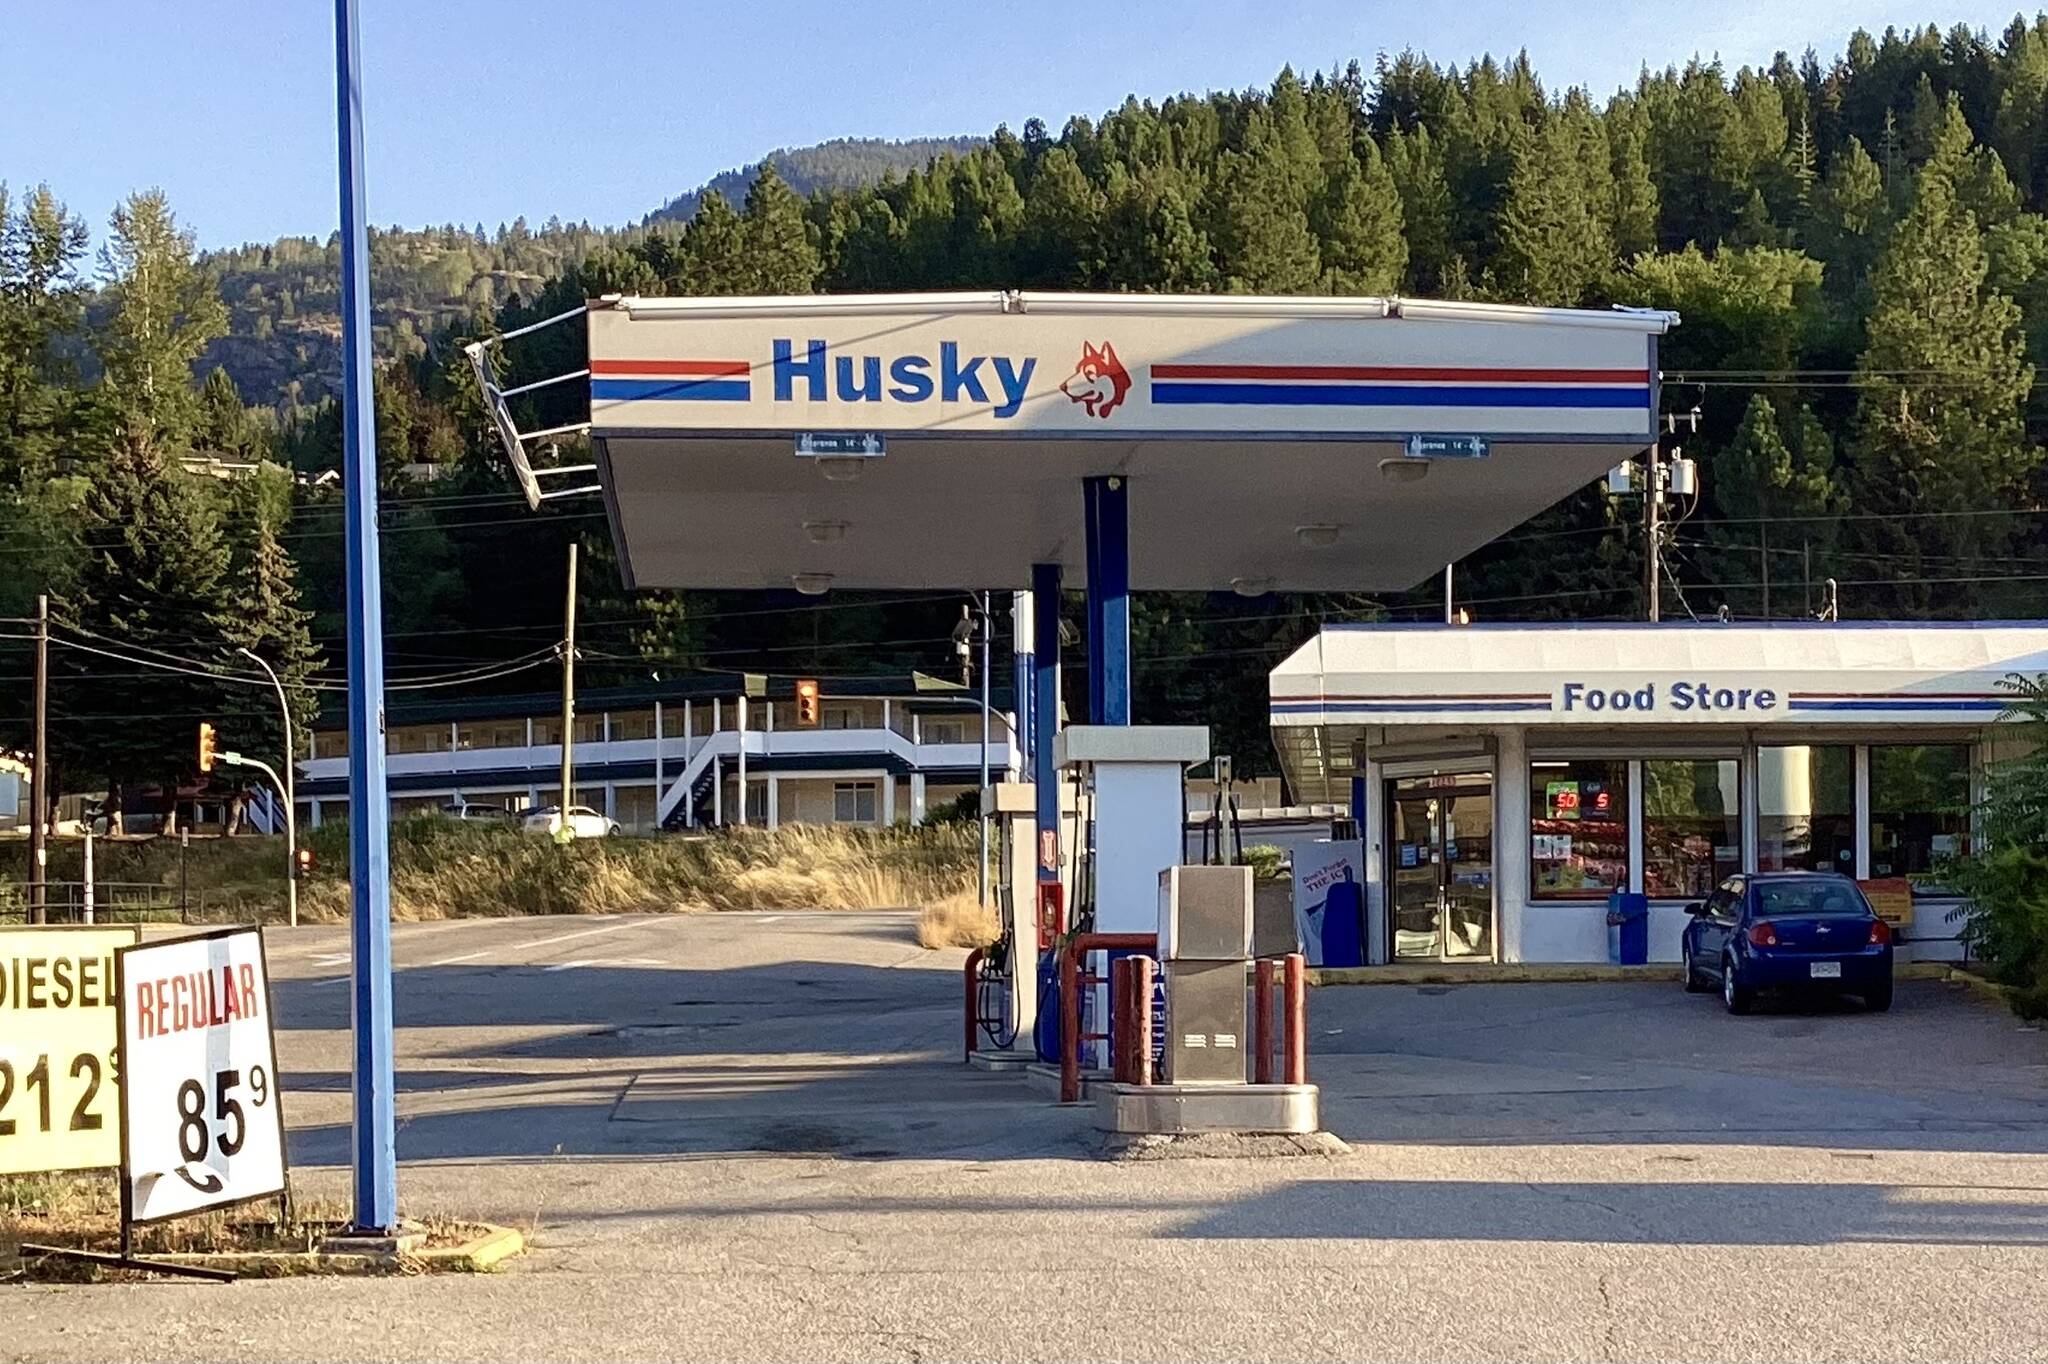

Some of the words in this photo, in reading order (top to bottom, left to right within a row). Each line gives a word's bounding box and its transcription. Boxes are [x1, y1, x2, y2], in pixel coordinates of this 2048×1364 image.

[772, 339, 1037, 418] Husky
[1563, 682, 1655, 711] Food
[1670, 681, 1777, 711] Store
[137, 963, 258, 1040] REGULAR
